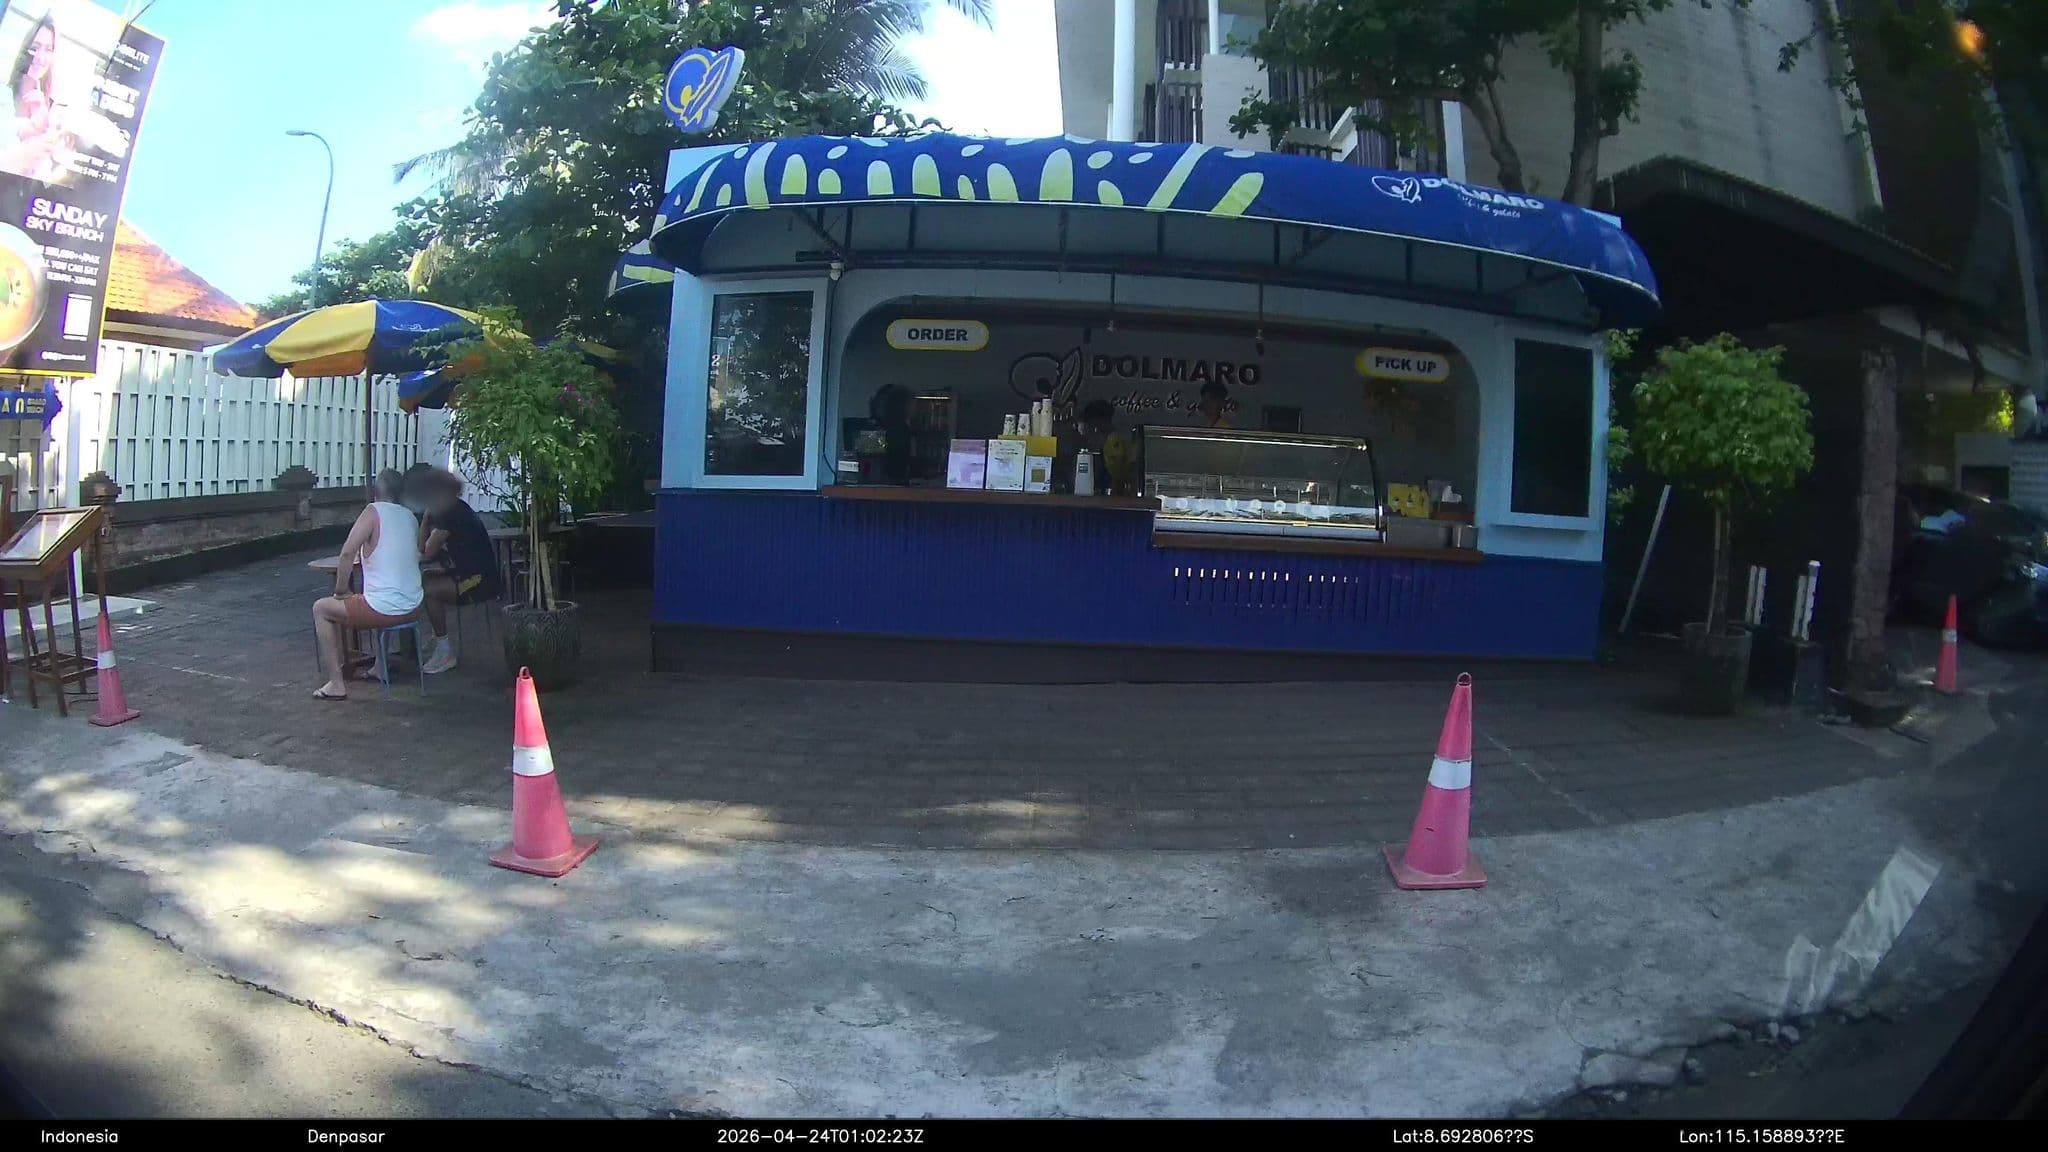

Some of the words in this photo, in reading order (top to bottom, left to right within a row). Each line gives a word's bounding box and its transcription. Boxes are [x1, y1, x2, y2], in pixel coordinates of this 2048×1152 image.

[32, 197, 108, 229] SUNDAY
[25, 216, 53, 233] SKY
[55, 222, 104, 242] BRUNCH
[907, 328, 968, 341] ORDER
[1092, 354, 1262, 386] DOLMARO
[1375, 356, 1411, 371] PICK
[1416, 358, 1436, 373] UP
[1111, 389, 1161, 414] coffee
[1166, 391, 1182, 410] &
